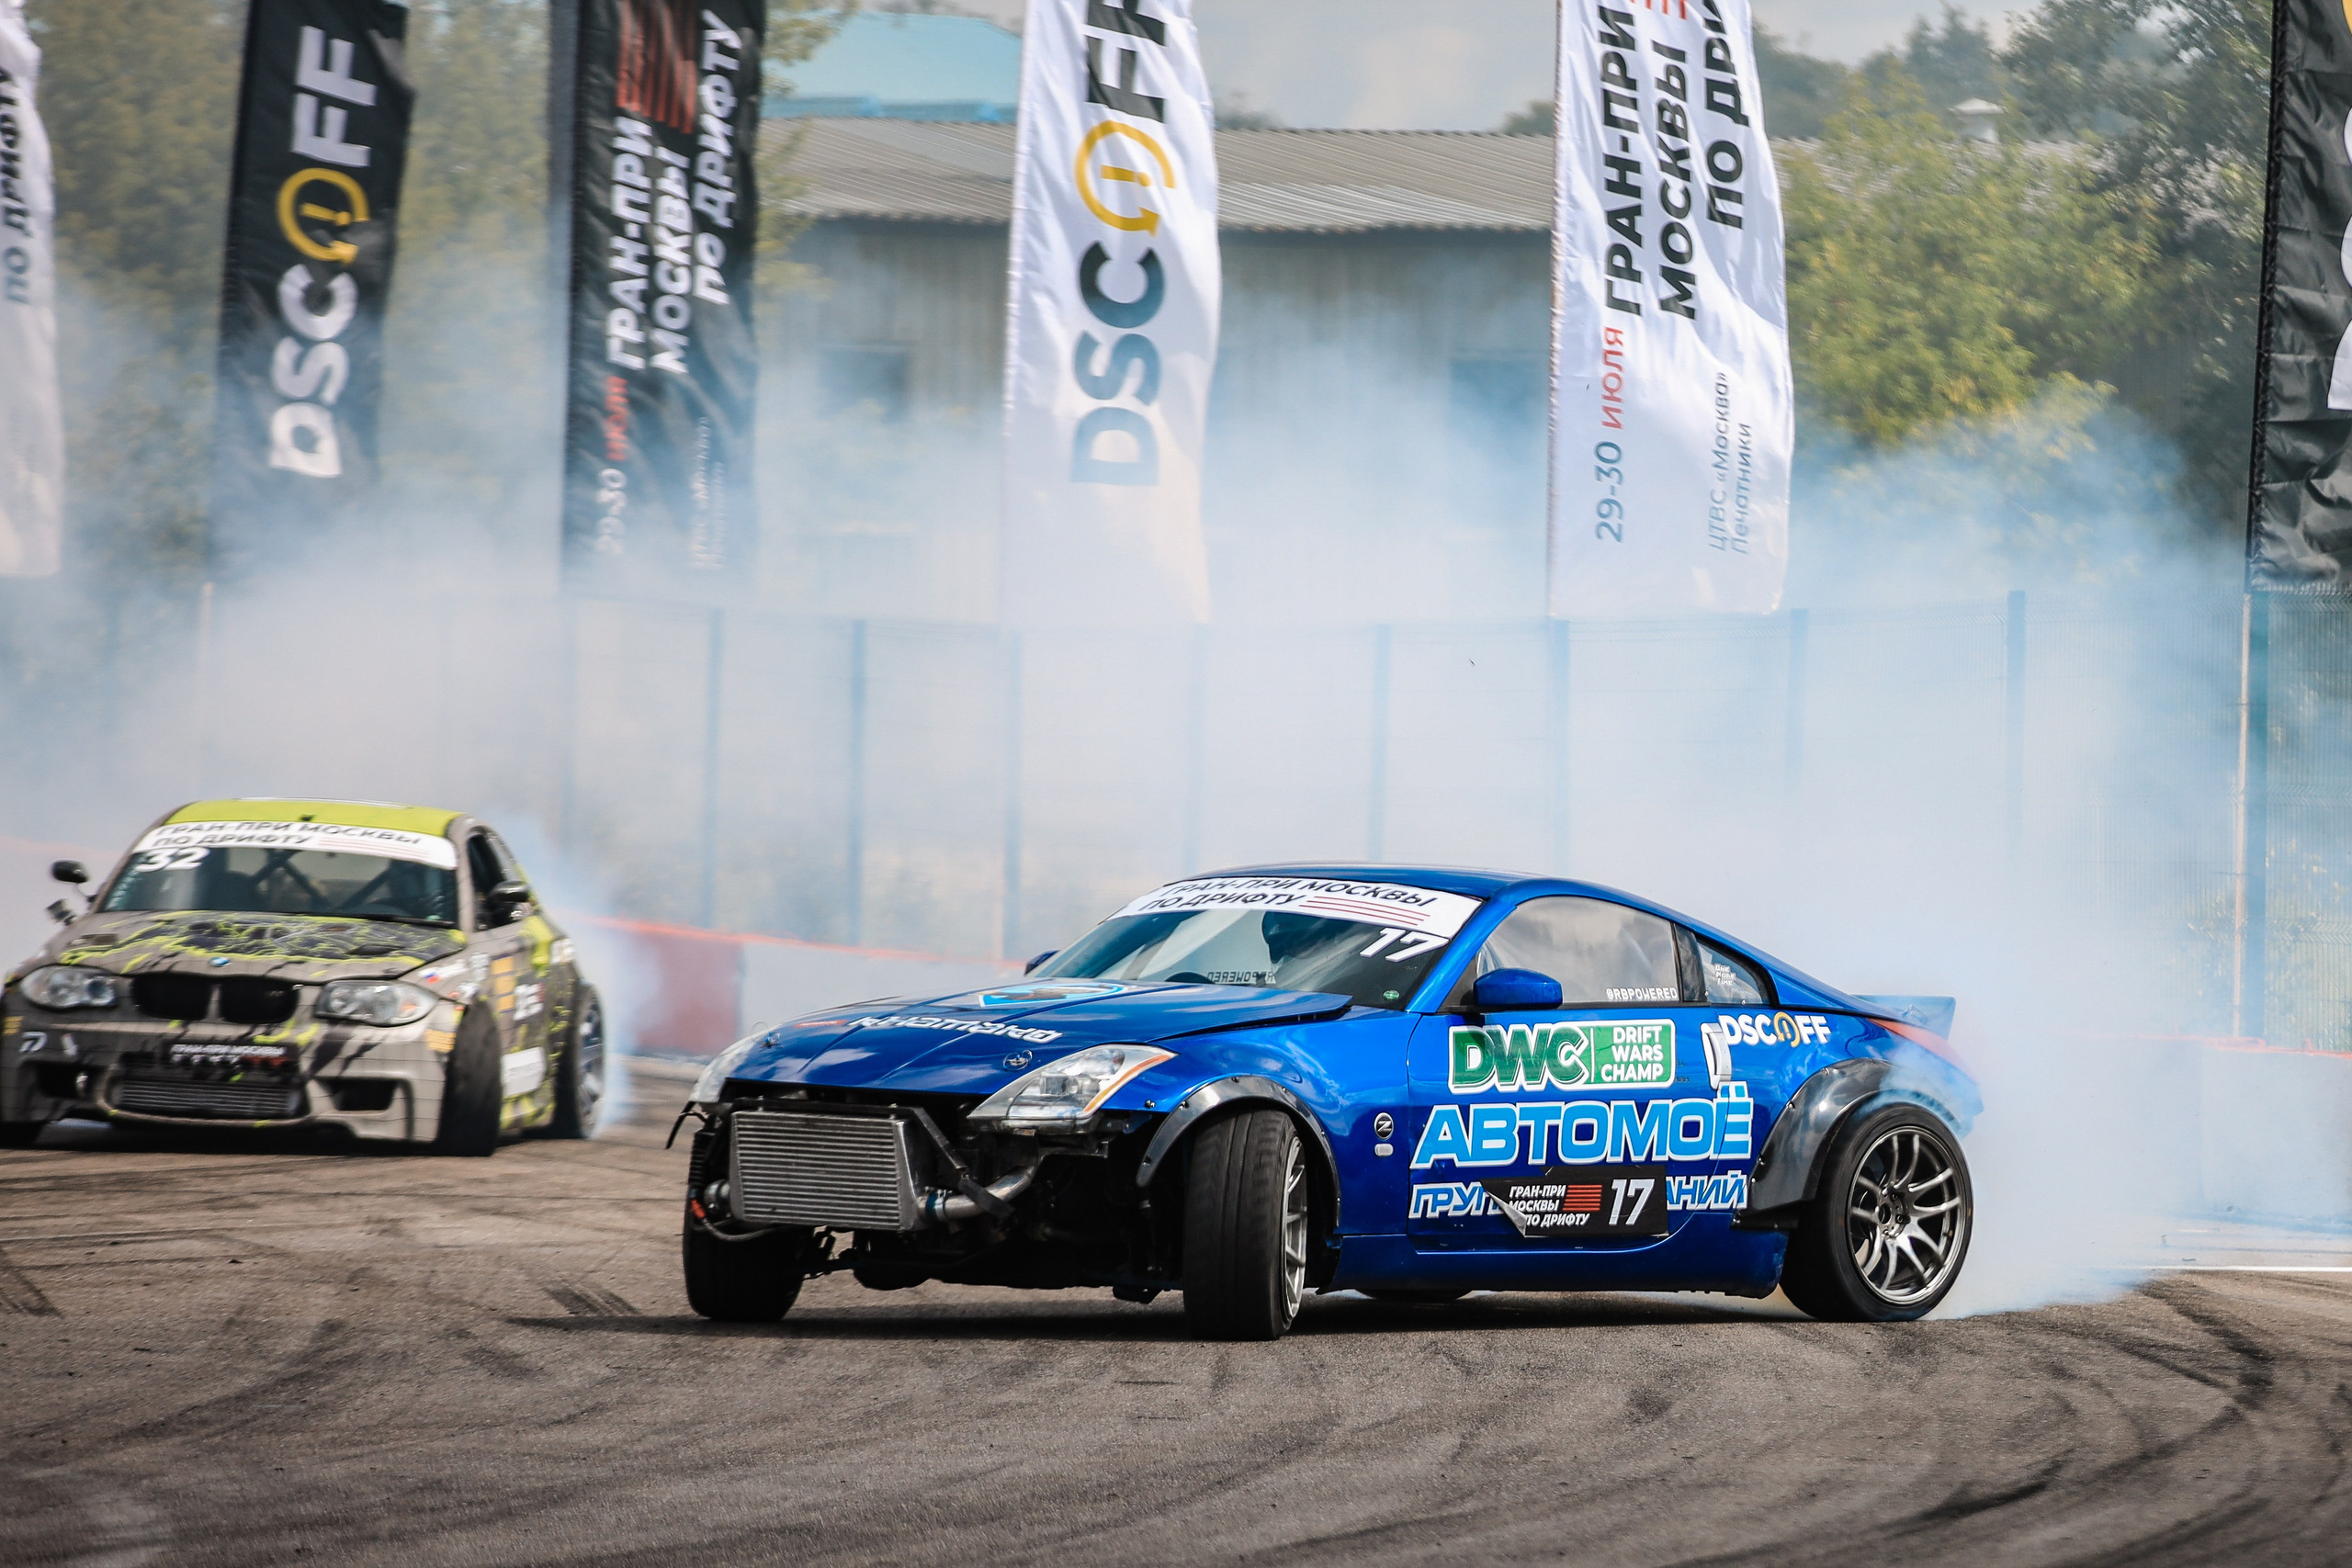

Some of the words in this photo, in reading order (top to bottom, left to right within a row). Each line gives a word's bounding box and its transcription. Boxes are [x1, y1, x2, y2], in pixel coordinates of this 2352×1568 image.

[691, 8, 743, 230] ДРИФТУ
[1597, 5, 1644, 317] ГРАН-ПРИ
[1651, 39, 1698, 321] МОСКВЫ
[1705, 140, 1745, 230] ПО
[605, 115, 653, 371] ГРАН-ПРИ
[650, 145, 693, 375] МОСКВЫ
[692, 231, 730, 306] ПО
[1600, 327, 1624, 430] ИЮЛЯ
[1712, 371, 1731, 482] «Москва»
[1594, 441, 1624, 543] 29-30
[1731, 423, 1753, 555] Печатники
[1708, 490, 1727, 552] ЦТВС
[135, 847, 211, 873] 32
[153, 834, 191, 847] ПО
[197, 833, 312, 845] ДРИФТУ
[299, 824, 422, 844] МОСКВЫ
[1138, 897, 1183, 911] ПО
[1177, 892, 1306, 908] ДРИФТУ
[1159, 879, 1303, 897] ГРАН-ПРИ
[1298, 879, 1438, 907] МОСКВЫ
[1359, 928, 1450, 963] 17
[1606, 987, 1679, 1000] @RBPOWERED
[1451, 1023, 1588, 1092] DWC
[1611, 1044, 1664, 1062] WARS
[1612, 1026, 1663, 1043] DRIFT
[1600, 1063, 1664, 1082] CHAMP
[1409, 1082, 1754, 1169] АВТОМОЁ
[1509, 1185, 1566, 1198] ГРАН-ПРИ
[1509, 1199, 1560, 1212] МОСКВЫ
[1608, 1179, 1655, 1225] 17
[1540, 1213, 1590, 1228] ДРИФТУ
